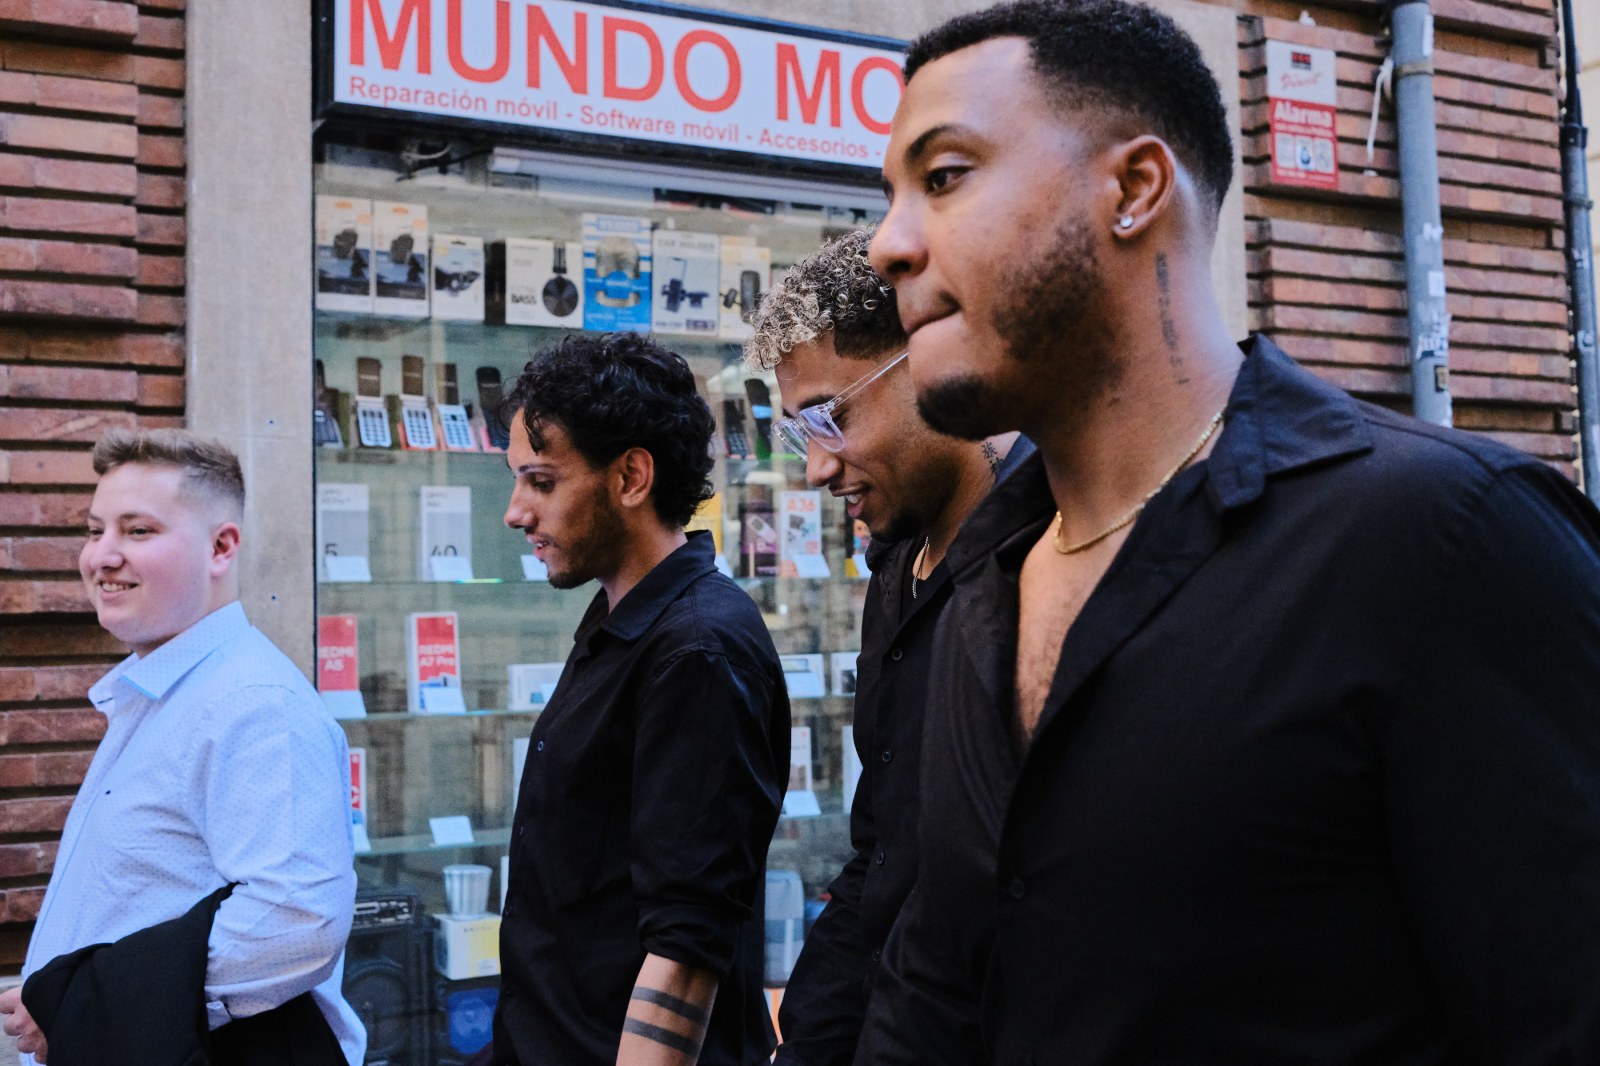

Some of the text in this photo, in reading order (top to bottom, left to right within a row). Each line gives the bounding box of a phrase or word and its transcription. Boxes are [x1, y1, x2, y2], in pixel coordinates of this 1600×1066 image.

[349, 0, 743, 113] MUNDO
[350, 76, 487, 111] Reparación
[496, 97, 558, 120] móvil
[580, 105, 676, 135] Software
[683, 120, 739, 143] móvil
[759, 128, 869, 159] Accesorios
[1274, 100, 1333, 128] Alarma
[511, 294, 537, 305] BASS
